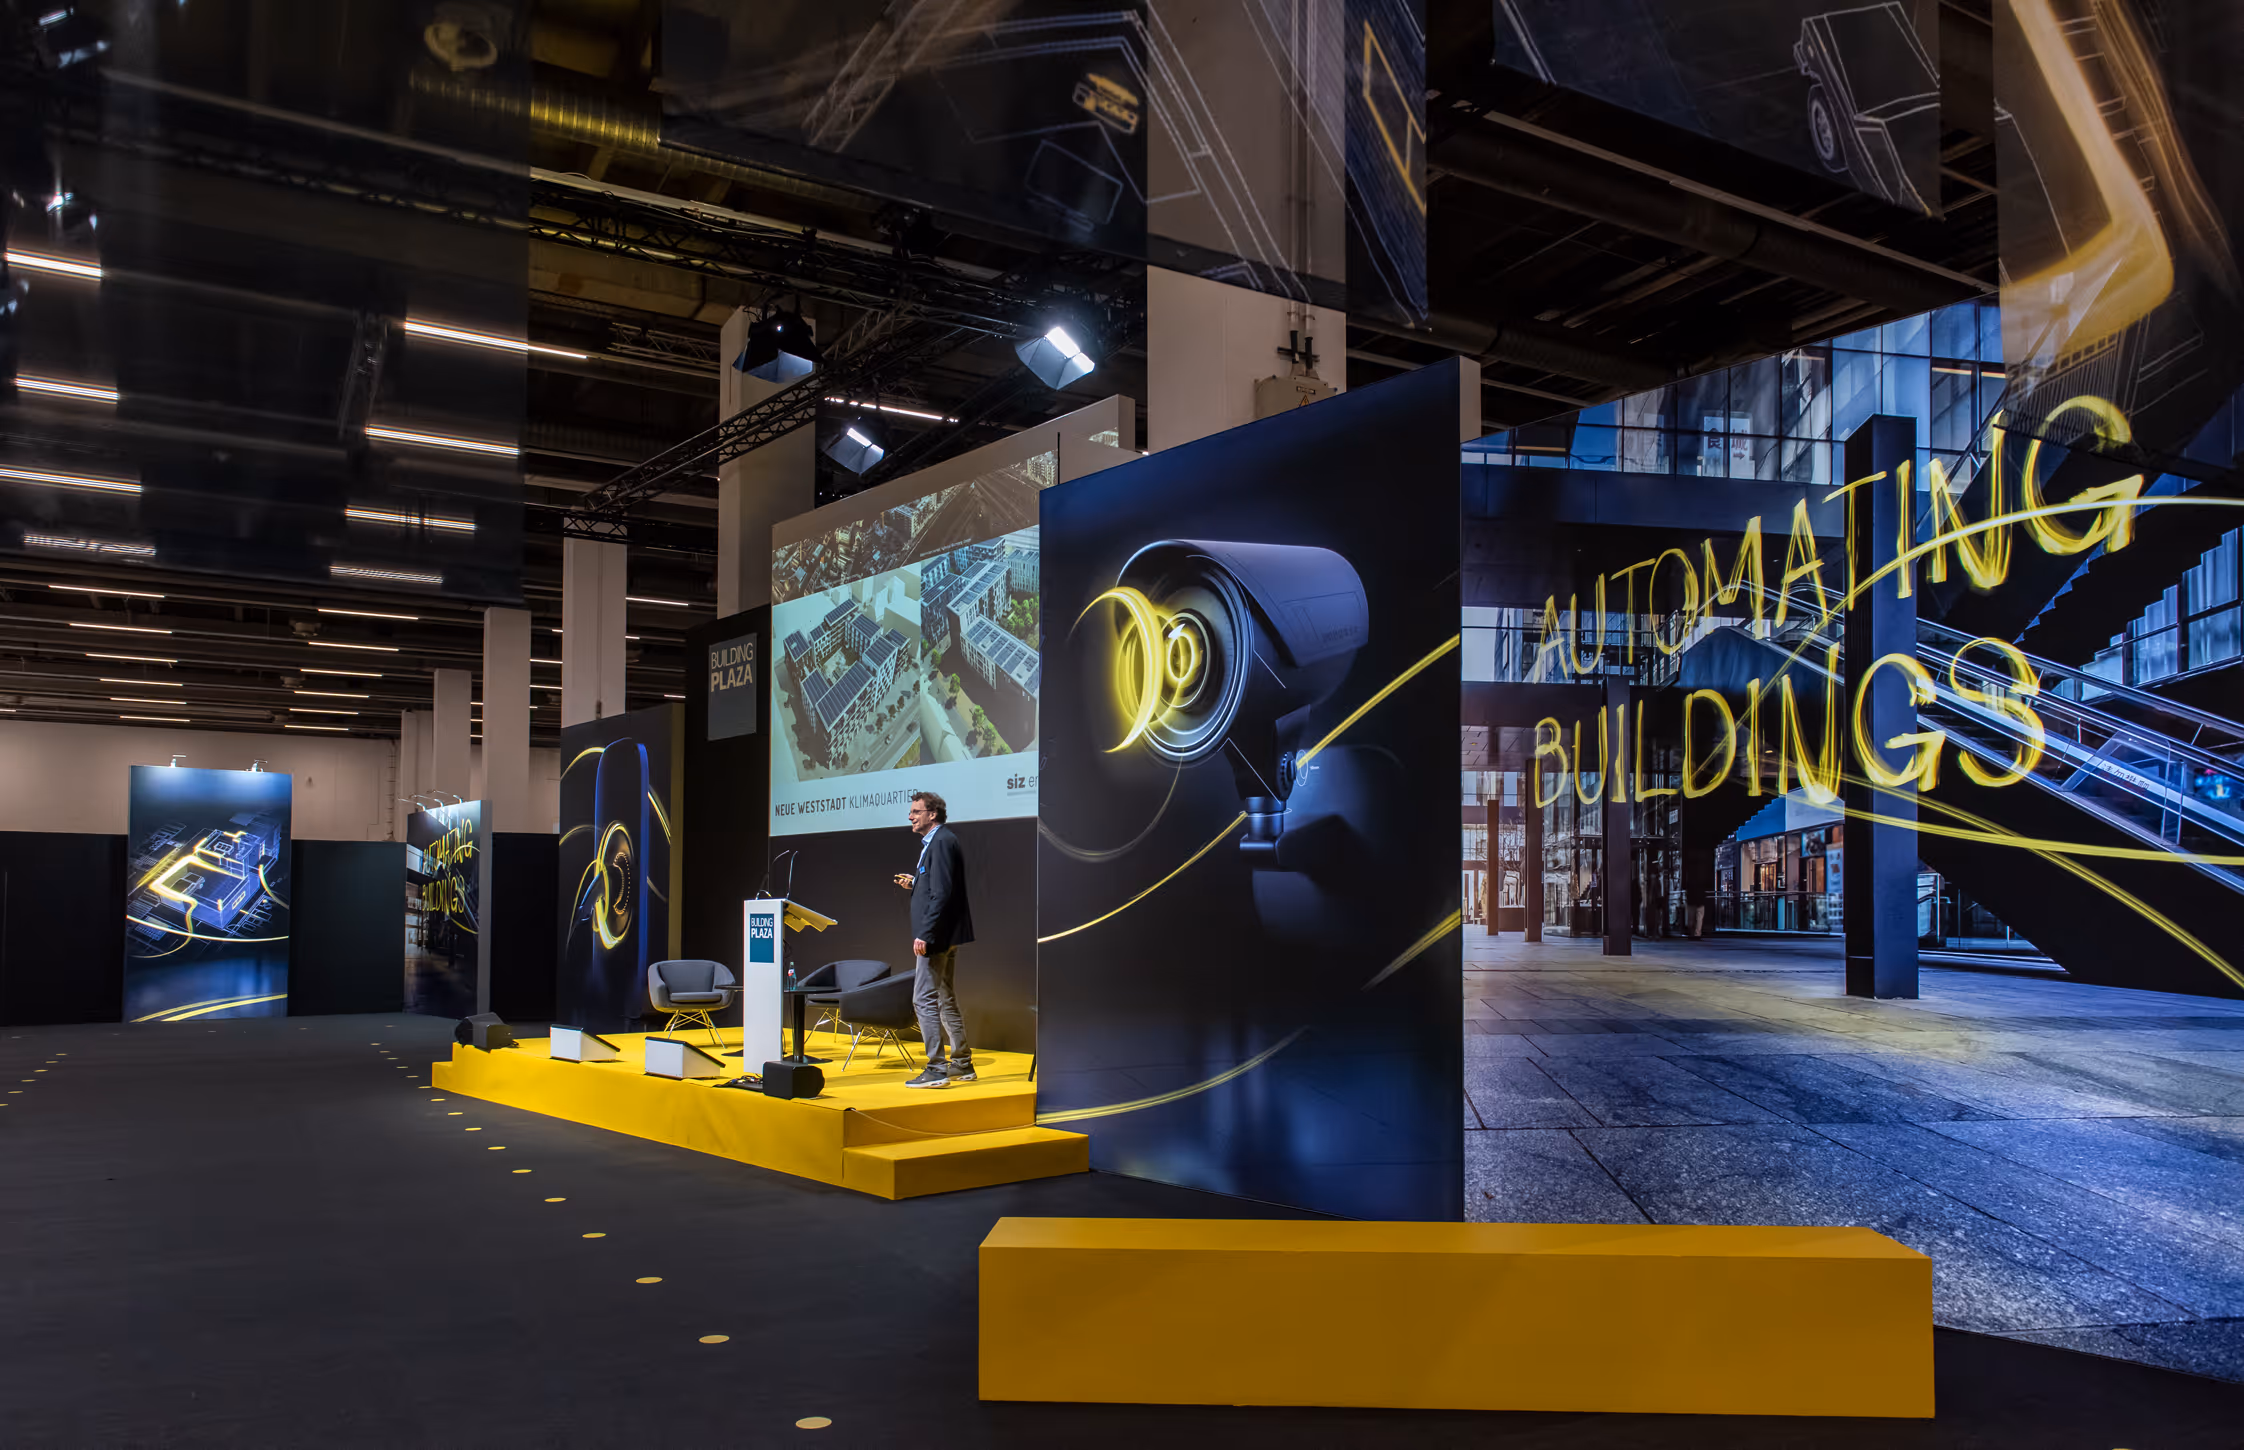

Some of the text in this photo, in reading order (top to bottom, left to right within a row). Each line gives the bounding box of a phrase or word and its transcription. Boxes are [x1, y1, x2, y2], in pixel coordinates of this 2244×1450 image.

[1532, 395, 2144, 684] AUTOMATING
[711, 642, 754, 670] BUILDING
[710, 663, 753, 693] PLAZA
[1534, 637, 2044, 808] BUILDINGS
[1006, 773, 1026, 790] siz
[775, 802, 796, 817] NEUE
[797, 796, 847, 815] WESTSTADT
[751, 917, 773, 927] BUILDING
[751, 927, 773, 939] PLAZA
